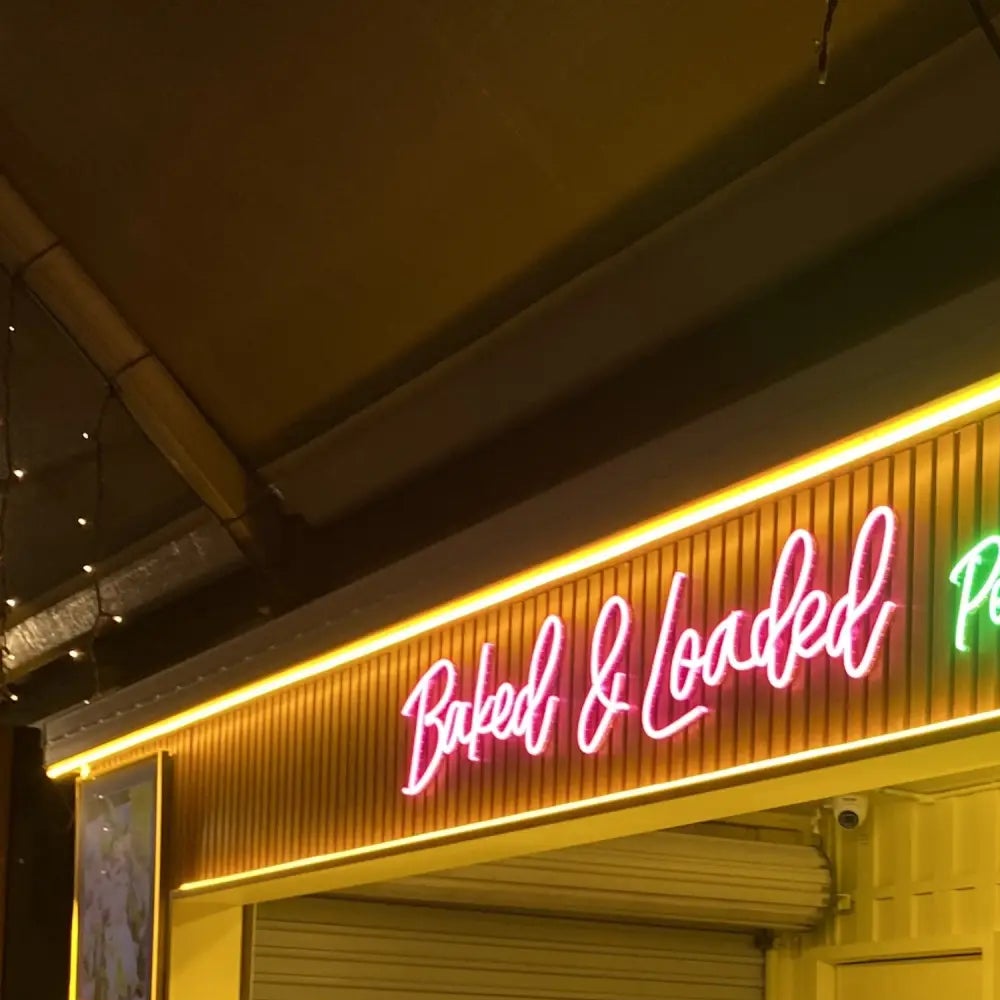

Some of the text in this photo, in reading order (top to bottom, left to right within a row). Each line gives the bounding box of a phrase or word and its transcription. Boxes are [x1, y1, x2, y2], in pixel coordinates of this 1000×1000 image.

[400, 505, 898, 796] Baked & Loaded
